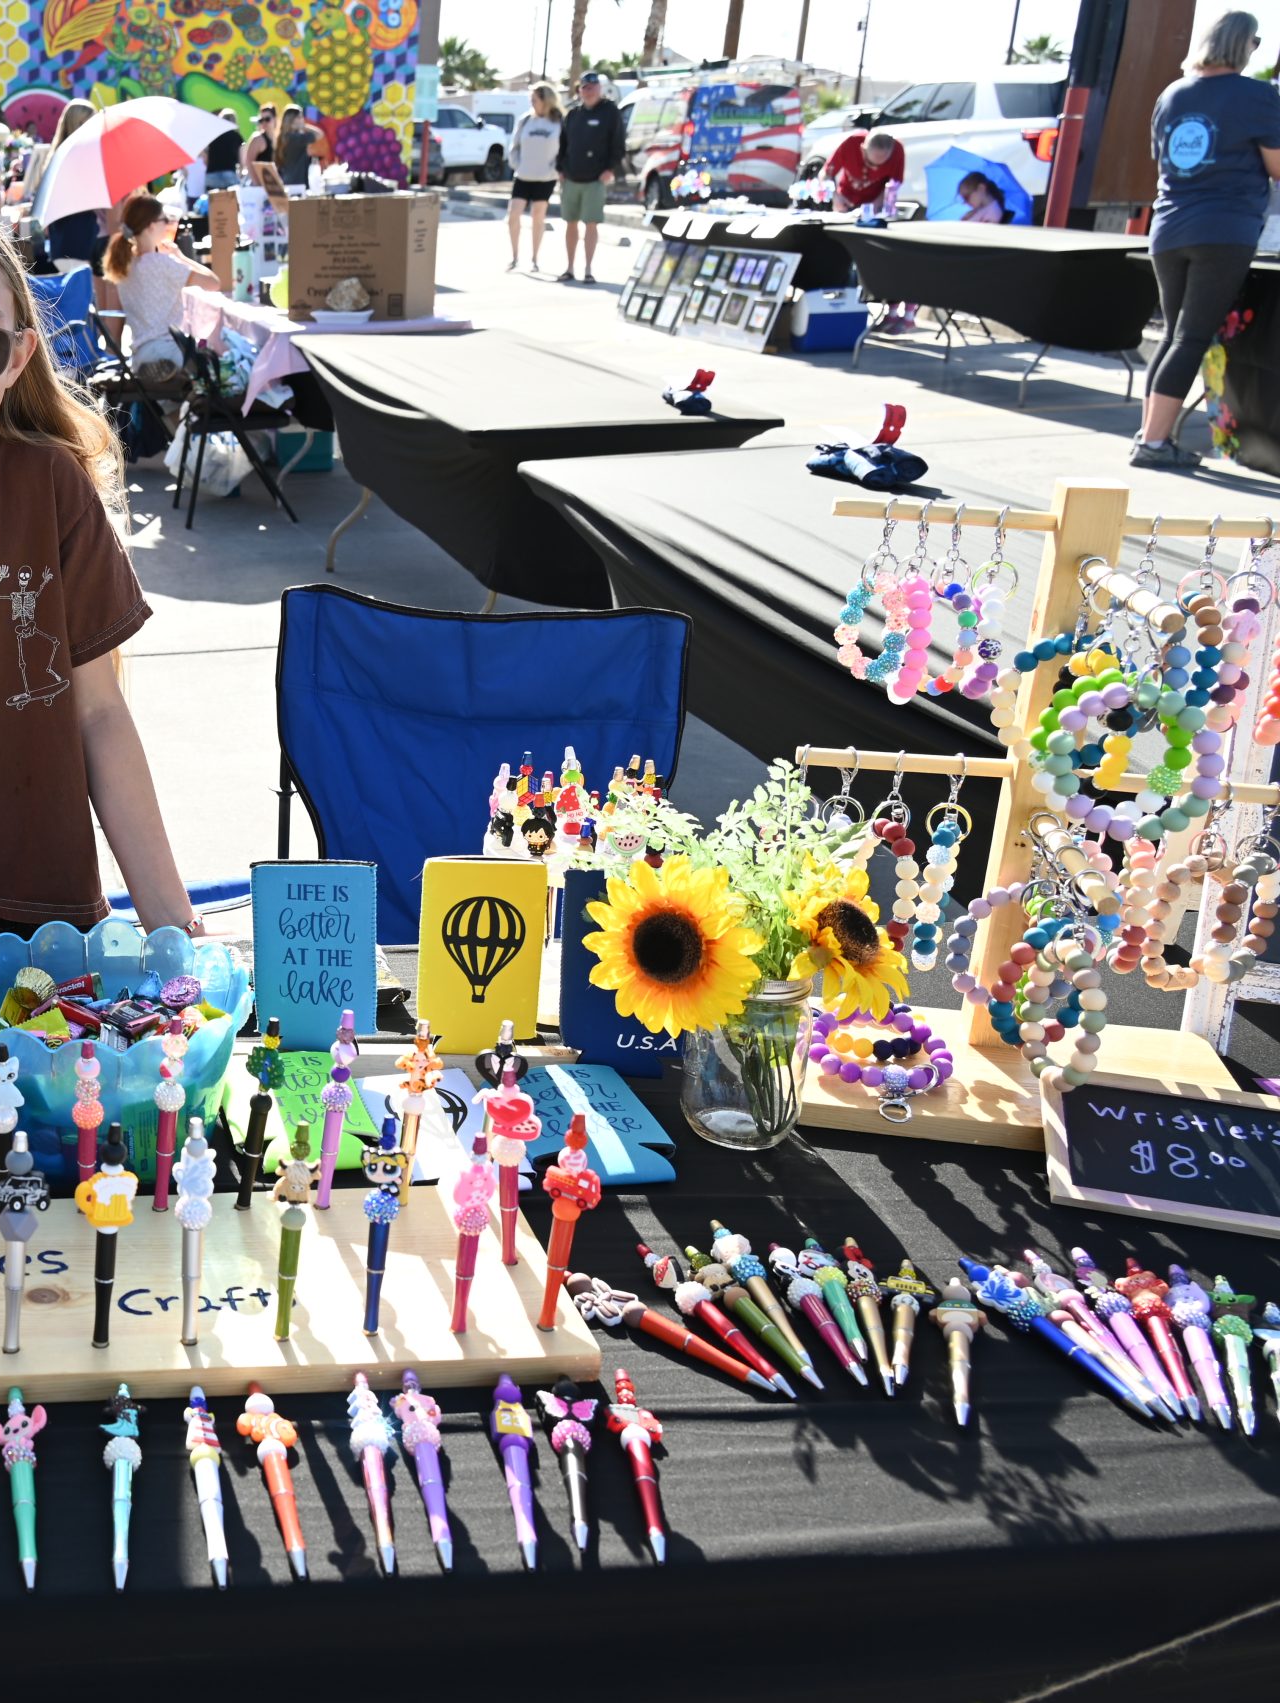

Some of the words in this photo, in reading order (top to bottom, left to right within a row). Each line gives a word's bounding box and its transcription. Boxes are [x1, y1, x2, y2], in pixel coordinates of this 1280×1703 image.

[287, 883, 326, 902] LIFE
[333, 885, 349, 903] IS
[279, 905, 356, 944] better
[282, 947, 309, 965] AT
[316, 948, 353, 967] THE
[301, 1056, 322, 1066] IS
